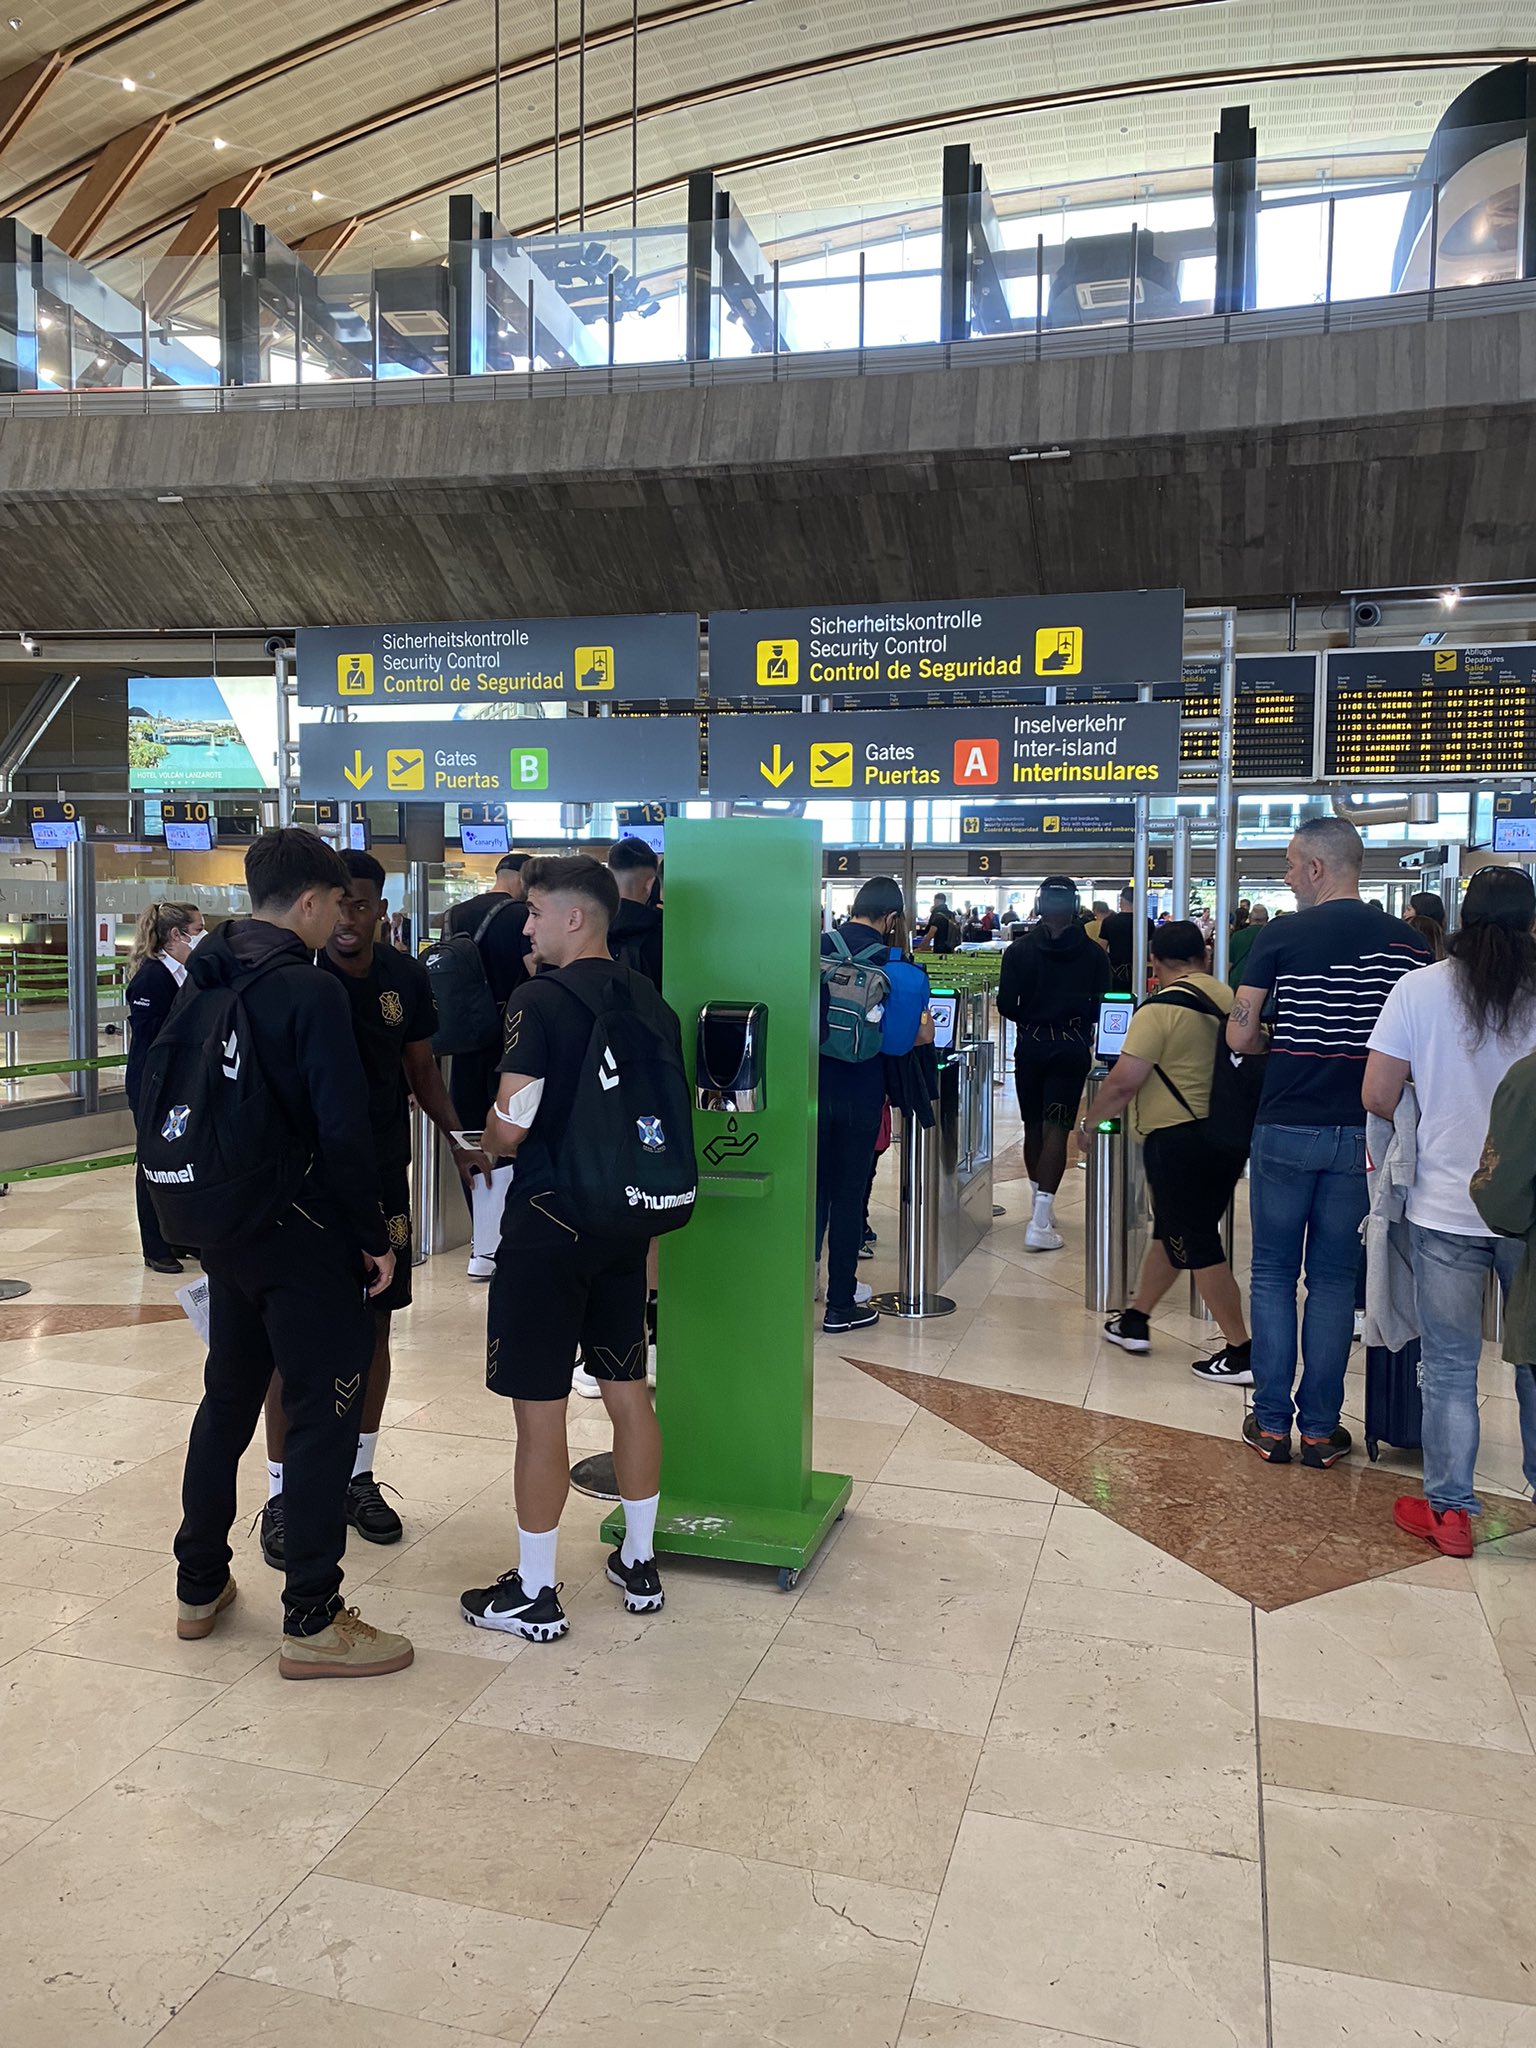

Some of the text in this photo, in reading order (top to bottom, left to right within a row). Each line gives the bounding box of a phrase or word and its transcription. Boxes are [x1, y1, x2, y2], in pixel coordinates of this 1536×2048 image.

[810, 611, 982, 635] Sicherheitskontrolle
[383, 630, 529, 650] Sicherheitskontrolle
[810, 635, 947, 660] Security Control
[383, 652, 500, 673] Security Control
[810, 655, 1022, 682] Control de Seguridad
[1465, 656, 1504, 664] Departures
[1465, 664, 1493, 672] Salidas
[384, 672, 564, 694] Control de Seguridad
[1367, 691, 1412, 699] G.CANARIA
[1014, 714, 1127, 734] Inselverkehr
[865, 743, 915, 761] Gates
[1013, 737, 1117, 758] Inter-island
[434, 750, 477, 767] Gates
[964, 747, 988, 777] A
[159, 771, 184, 779] VOLCÁN
[520, 755, 539, 782] B
[864, 765, 940, 785] Puertas
[1013, 761, 1159, 782] Interinsulares
[435, 771, 500, 789] Puertas
[63, 803, 76, 819] 9
[184, 804, 207, 821] 10
[482, 806, 505, 822] 12
[641, 805, 665, 822] 13
[475, 838, 503, 847] canaryfly
[838, 856, 848, 871] 2
[979, 855, 990, 871] 3
[1147, 855, 1155, 871] 4
[142, 1163, 195, 1184] hummel
[642, 1186, 696, 1210] hummel
